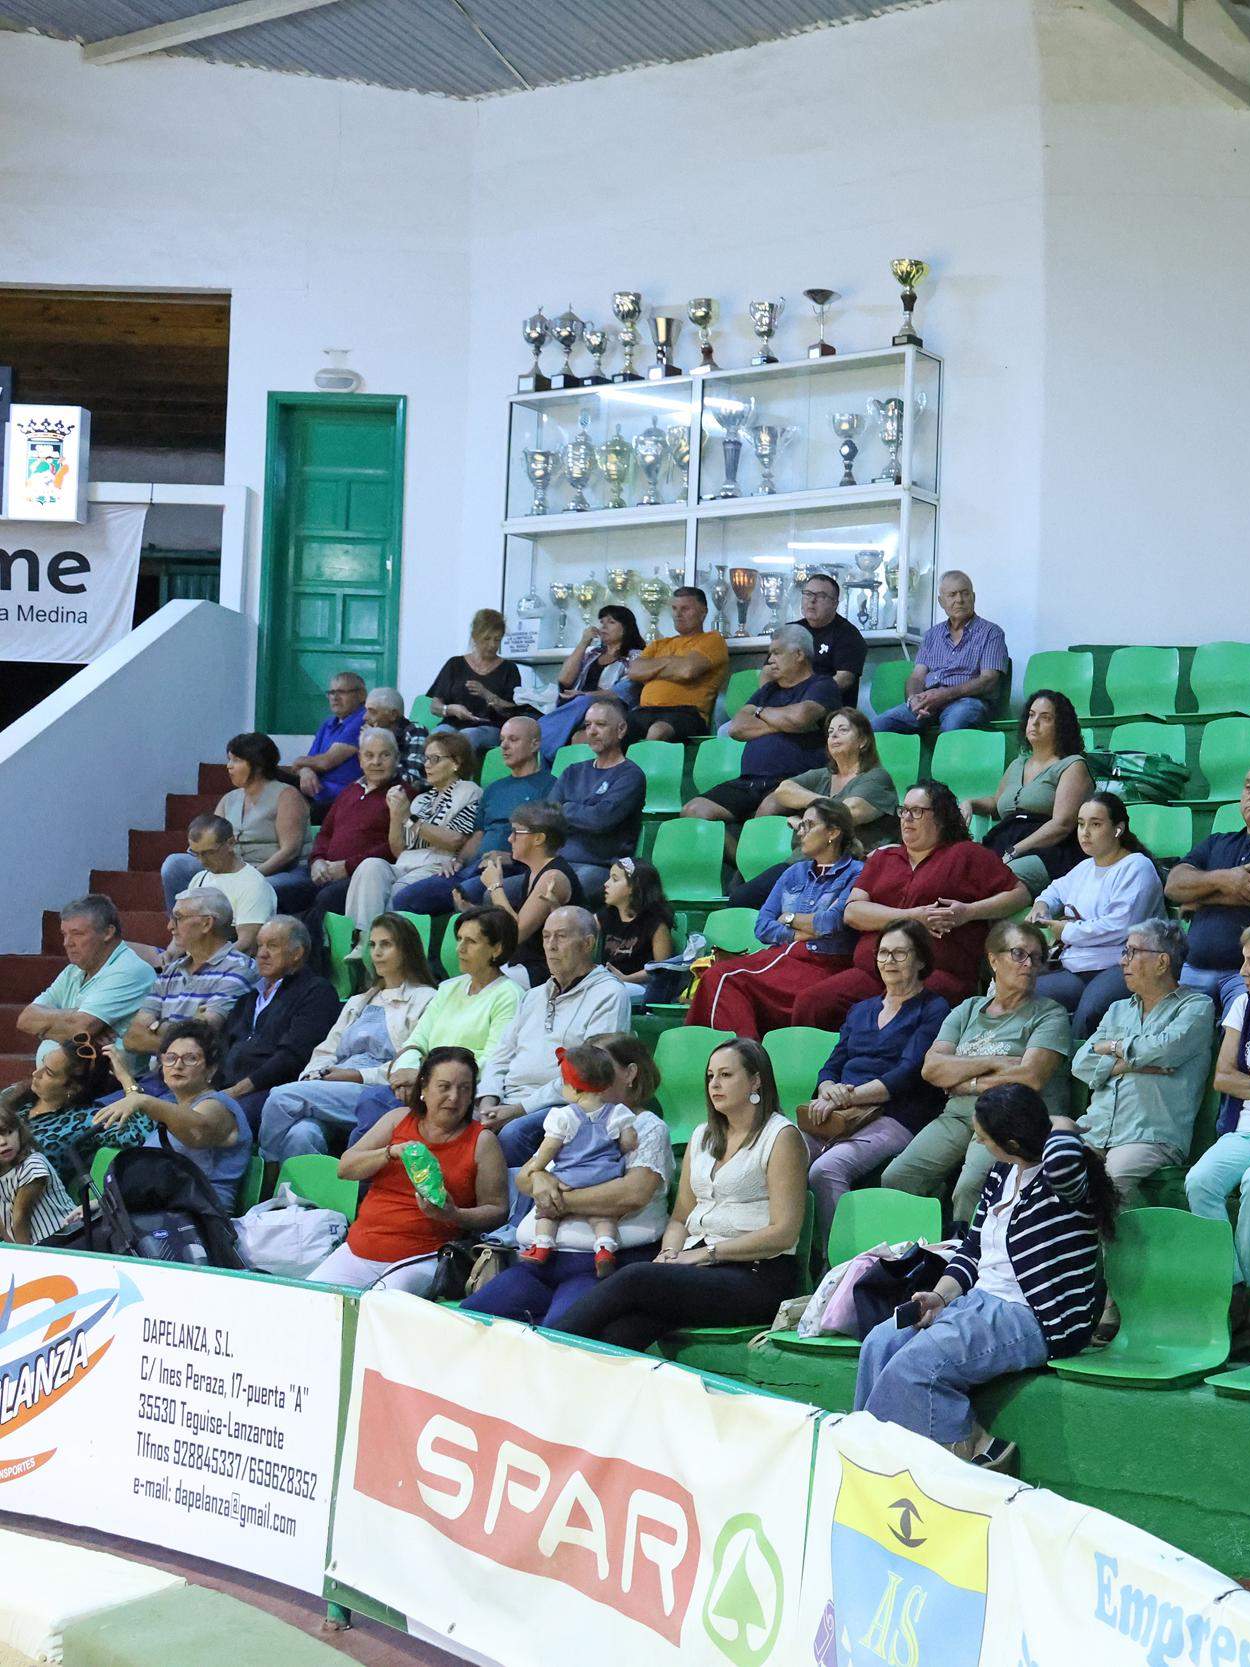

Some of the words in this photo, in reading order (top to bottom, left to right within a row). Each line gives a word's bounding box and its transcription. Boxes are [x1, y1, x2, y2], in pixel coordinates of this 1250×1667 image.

[17, 604, 88, 624] Medina
[143, 1317, 210, 1356] DAPELANZA,
[214, 1329, 234, 1358] S.L.
[140, 1355, 156, 1381] C/
[159, 1358, 182, 1387] Ines
[186, 1363, 227, 1398] Peraza,
[231, 1372, 286, 1408] 17-puerta
[290, 1384, 309, 1413] "A"
[138, 1393, 177, 1424] 35530
[180, 1401, 285, 1450] Teguise-Lanzarote
[137, 1431, 170, 1463] Tlfnos
[173, 1439, 318, 1501] 928845337/659628352
[133, 1475, 171, 1502] e-mail:
[175, 1479, 297, 1537] dapelanza@gmail.com
[416, 1413, 689, 1617] SPAR
[858, 1570, 928, 1667] AS
